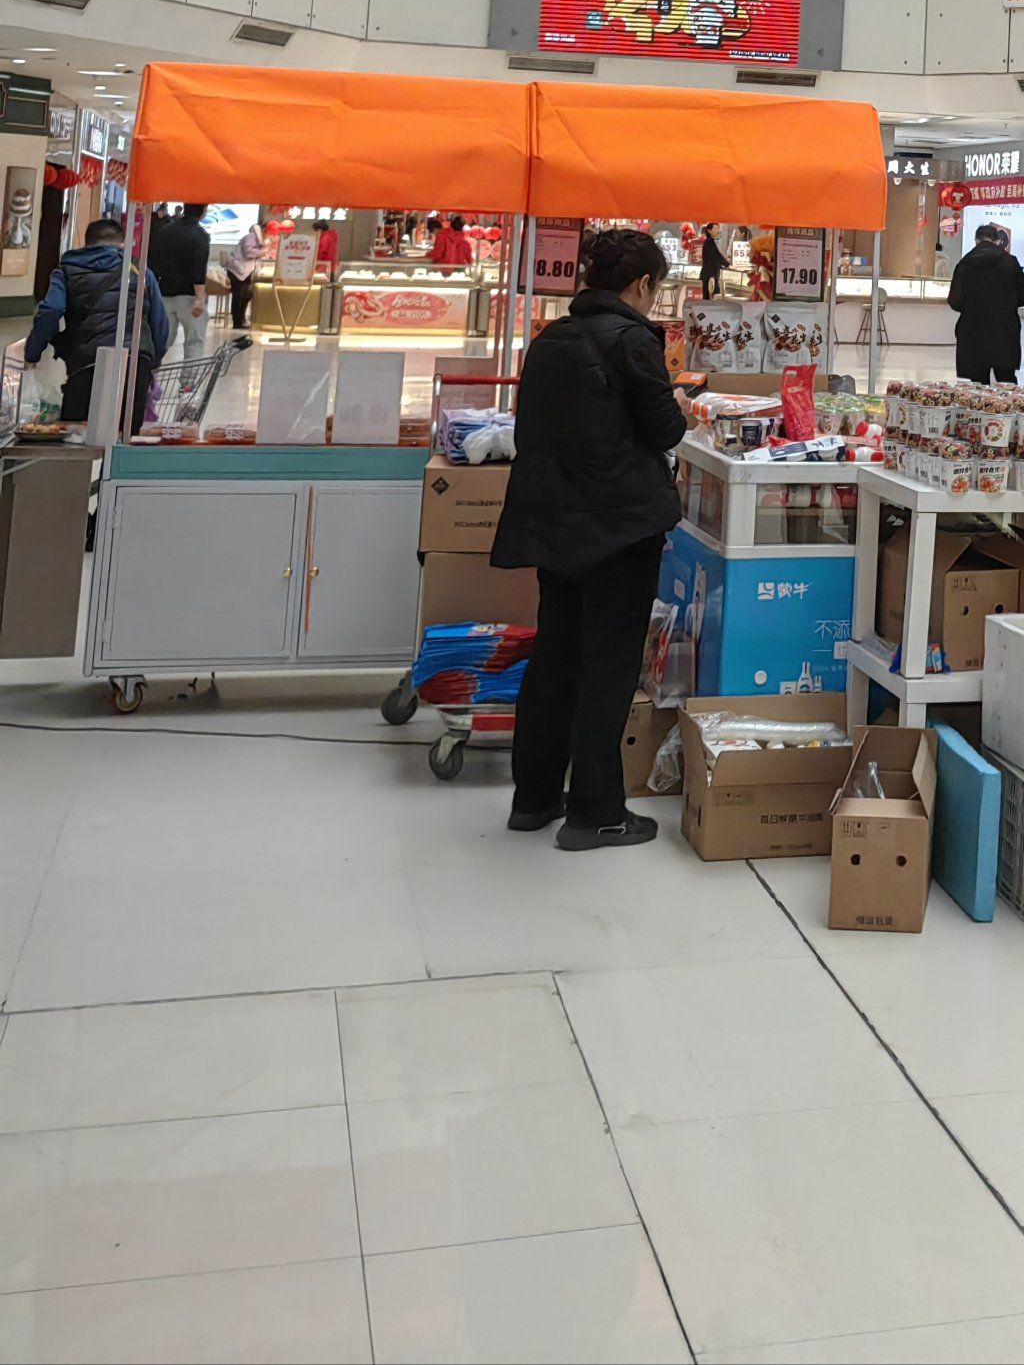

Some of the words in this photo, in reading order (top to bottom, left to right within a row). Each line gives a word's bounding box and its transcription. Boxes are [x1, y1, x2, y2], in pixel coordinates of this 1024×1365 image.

[533, 259, 575, 278] 8.80
[781, 268, 818, 285] 17.90
[777, 582, 810, 600] 蒙牛
